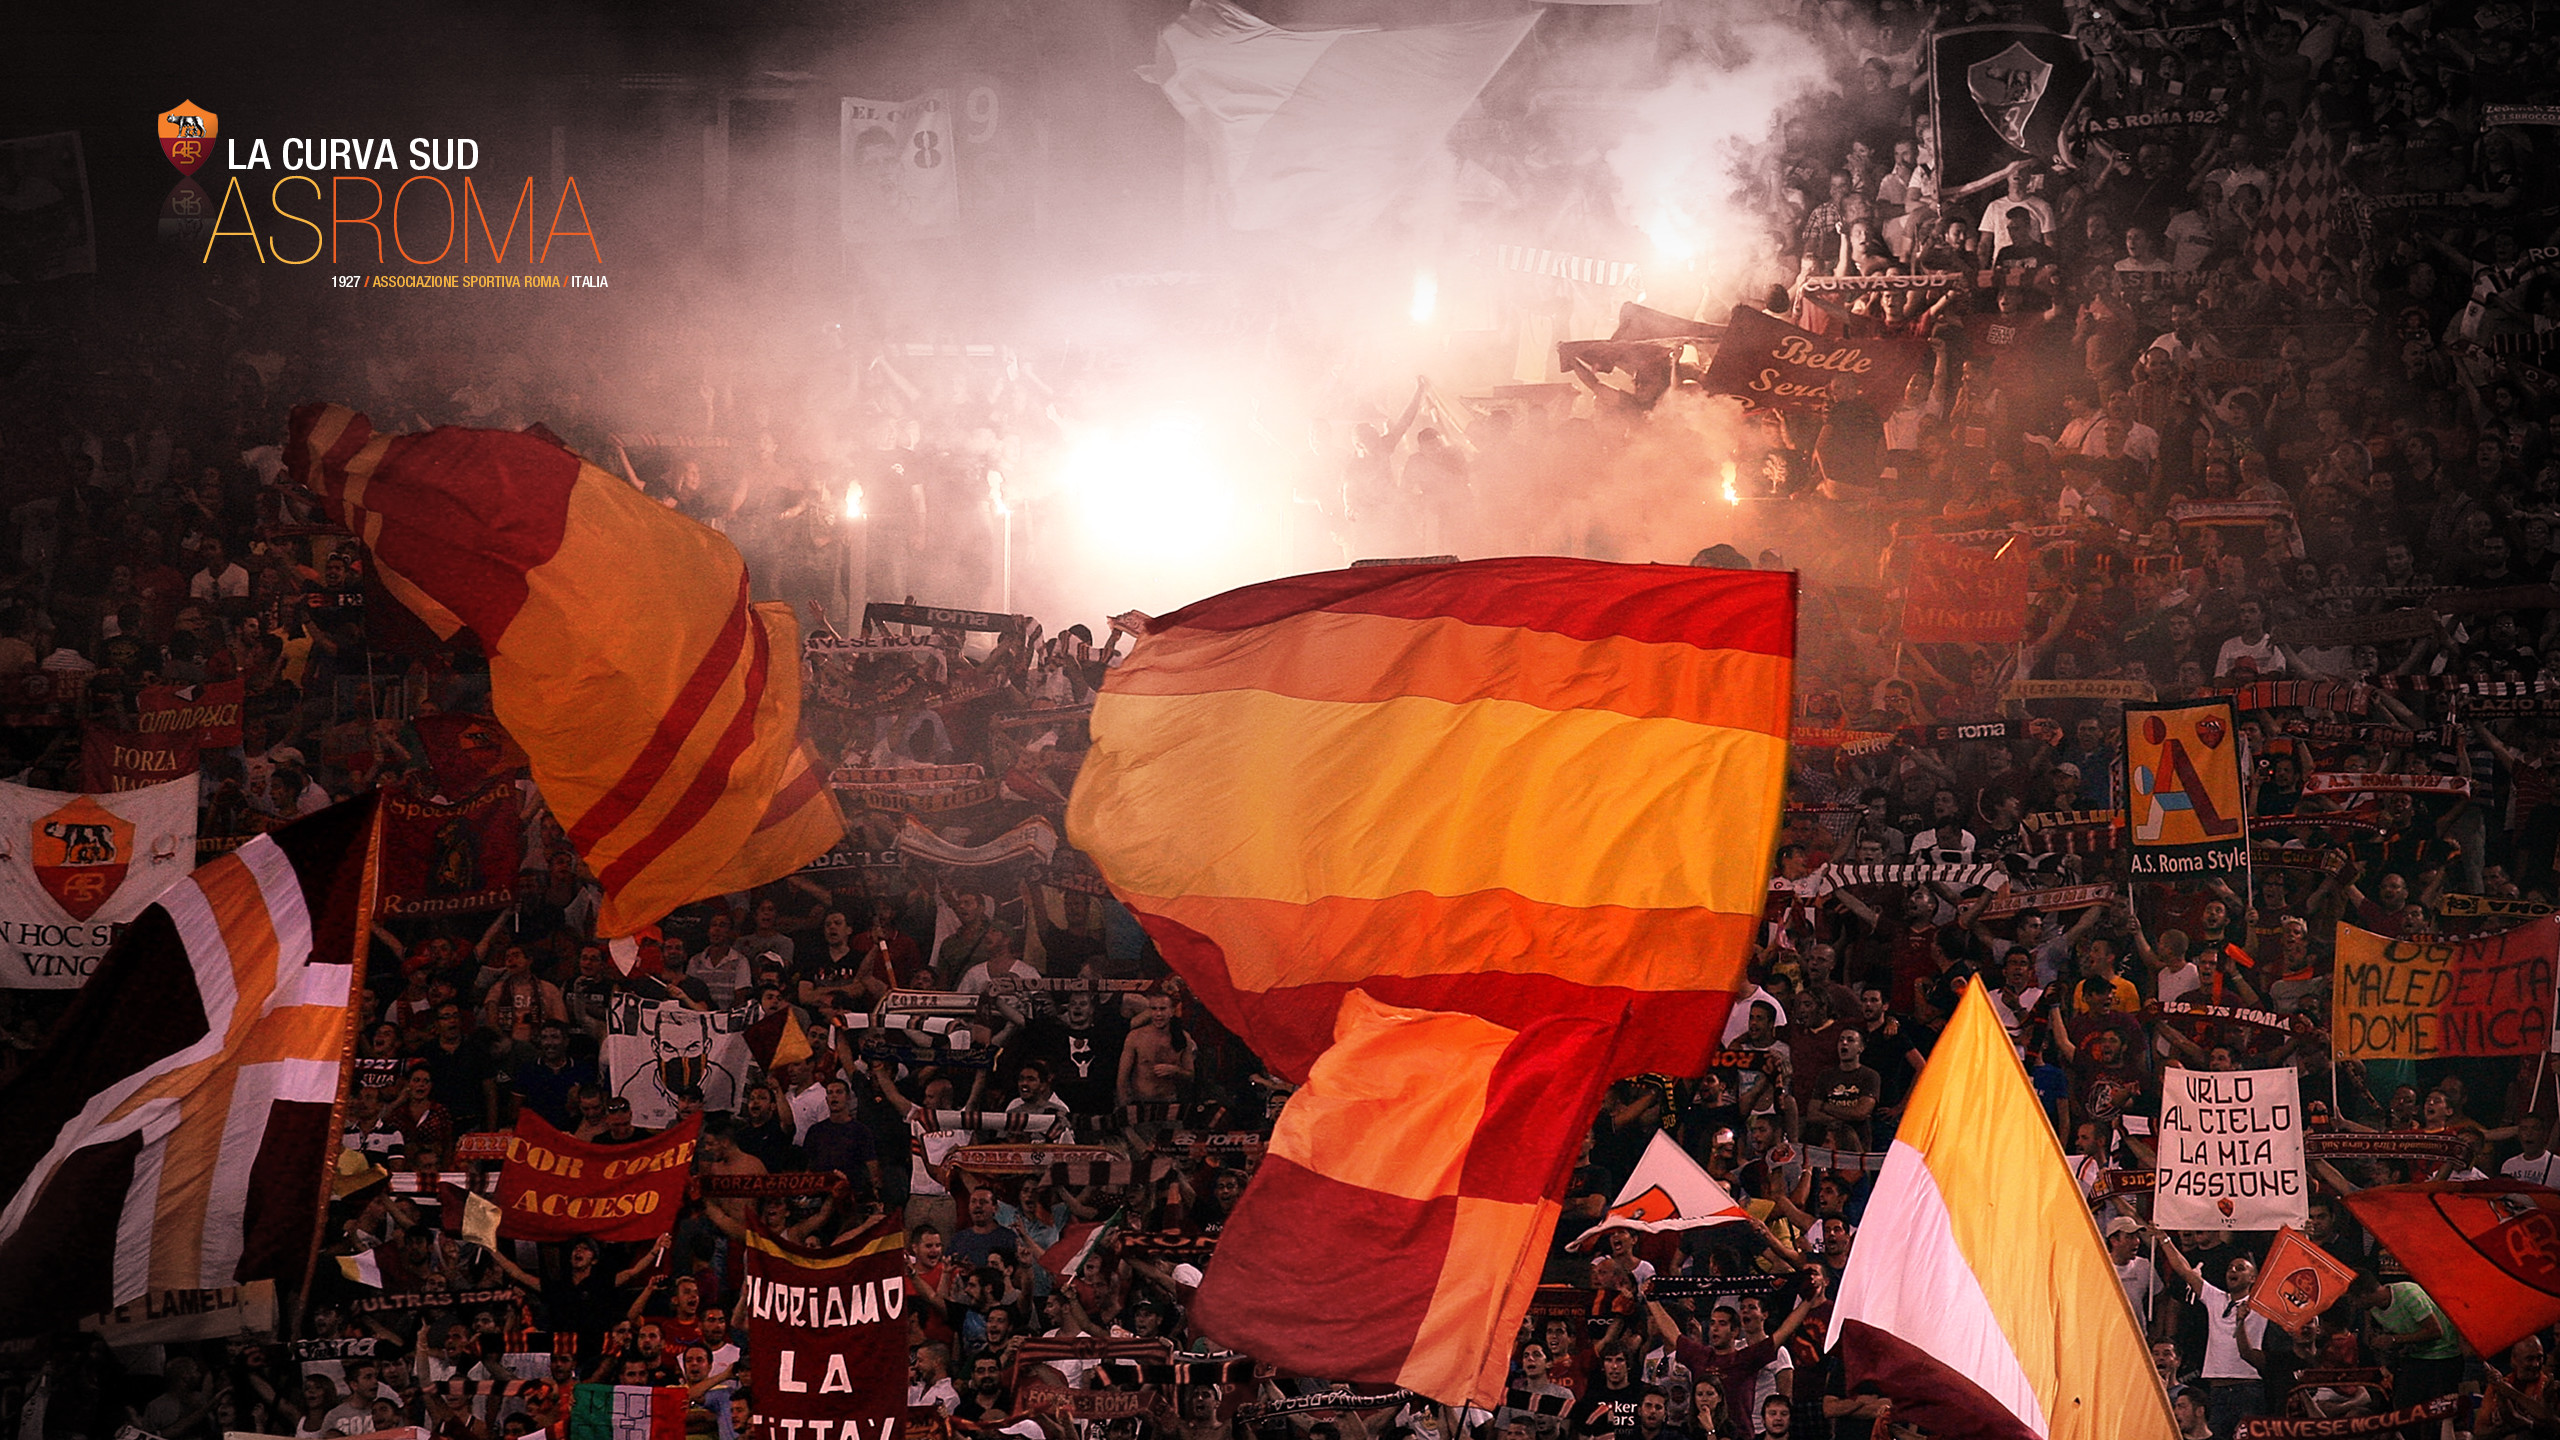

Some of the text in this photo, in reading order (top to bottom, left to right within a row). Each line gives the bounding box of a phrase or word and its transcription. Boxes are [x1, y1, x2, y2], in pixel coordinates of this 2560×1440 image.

[966, 86, 999, 143] 9
[2125, 111, 2183, 128] ROMA
[913, 130, 942, 169] 8
[1772, 334, 1874, 375] Belle
[925, 607, 990, 627] roma
[138, 702, 238, 734] amnesia
[2468, 698, 2535, 712] LAZIO
[1957, 722, 2005, 739] roma
[2373, 726, 2414, 743] ROMA
[113, 744, 178, 772] FORZA
[2328, 773, 2443, 788] A.S. ROMA 1927
[2131, 853, 2157, 873] A.S.
[2159, 854, 2205, 873] Roma
[2208, 846, 2248, 873] Style
[18, 922, 84, 948] HOC
[22, 952, 101, 977] VINC
[2341, 956, 2552, 1008] MALEDETTA
[2233, 1007, 2292, 1032] ROMA
[2348, 1005, 2546, 1055] DOMENICA
[355, 1058, 399, 1070] 1927
[2163, 1104, 2291, 1134] AL CIELO
[1205, 1132, 1260, 1146] roma
[2180, 1137, 2273, 1166] LA MIA
[505, 1135, 697, 1181] COR CORE
[711, 1173, 826, 1191] FORZA ROMA
[2158, 1168, 2300, 1198] PASSIONE
[512, 1189, 660, 1220] ACCESO
[362, 1289, 522, 1312] ULTRAS ROM
[778, 1350, 854, 1395] LA
[1094, 1394, 1141, 1412] ROMA
